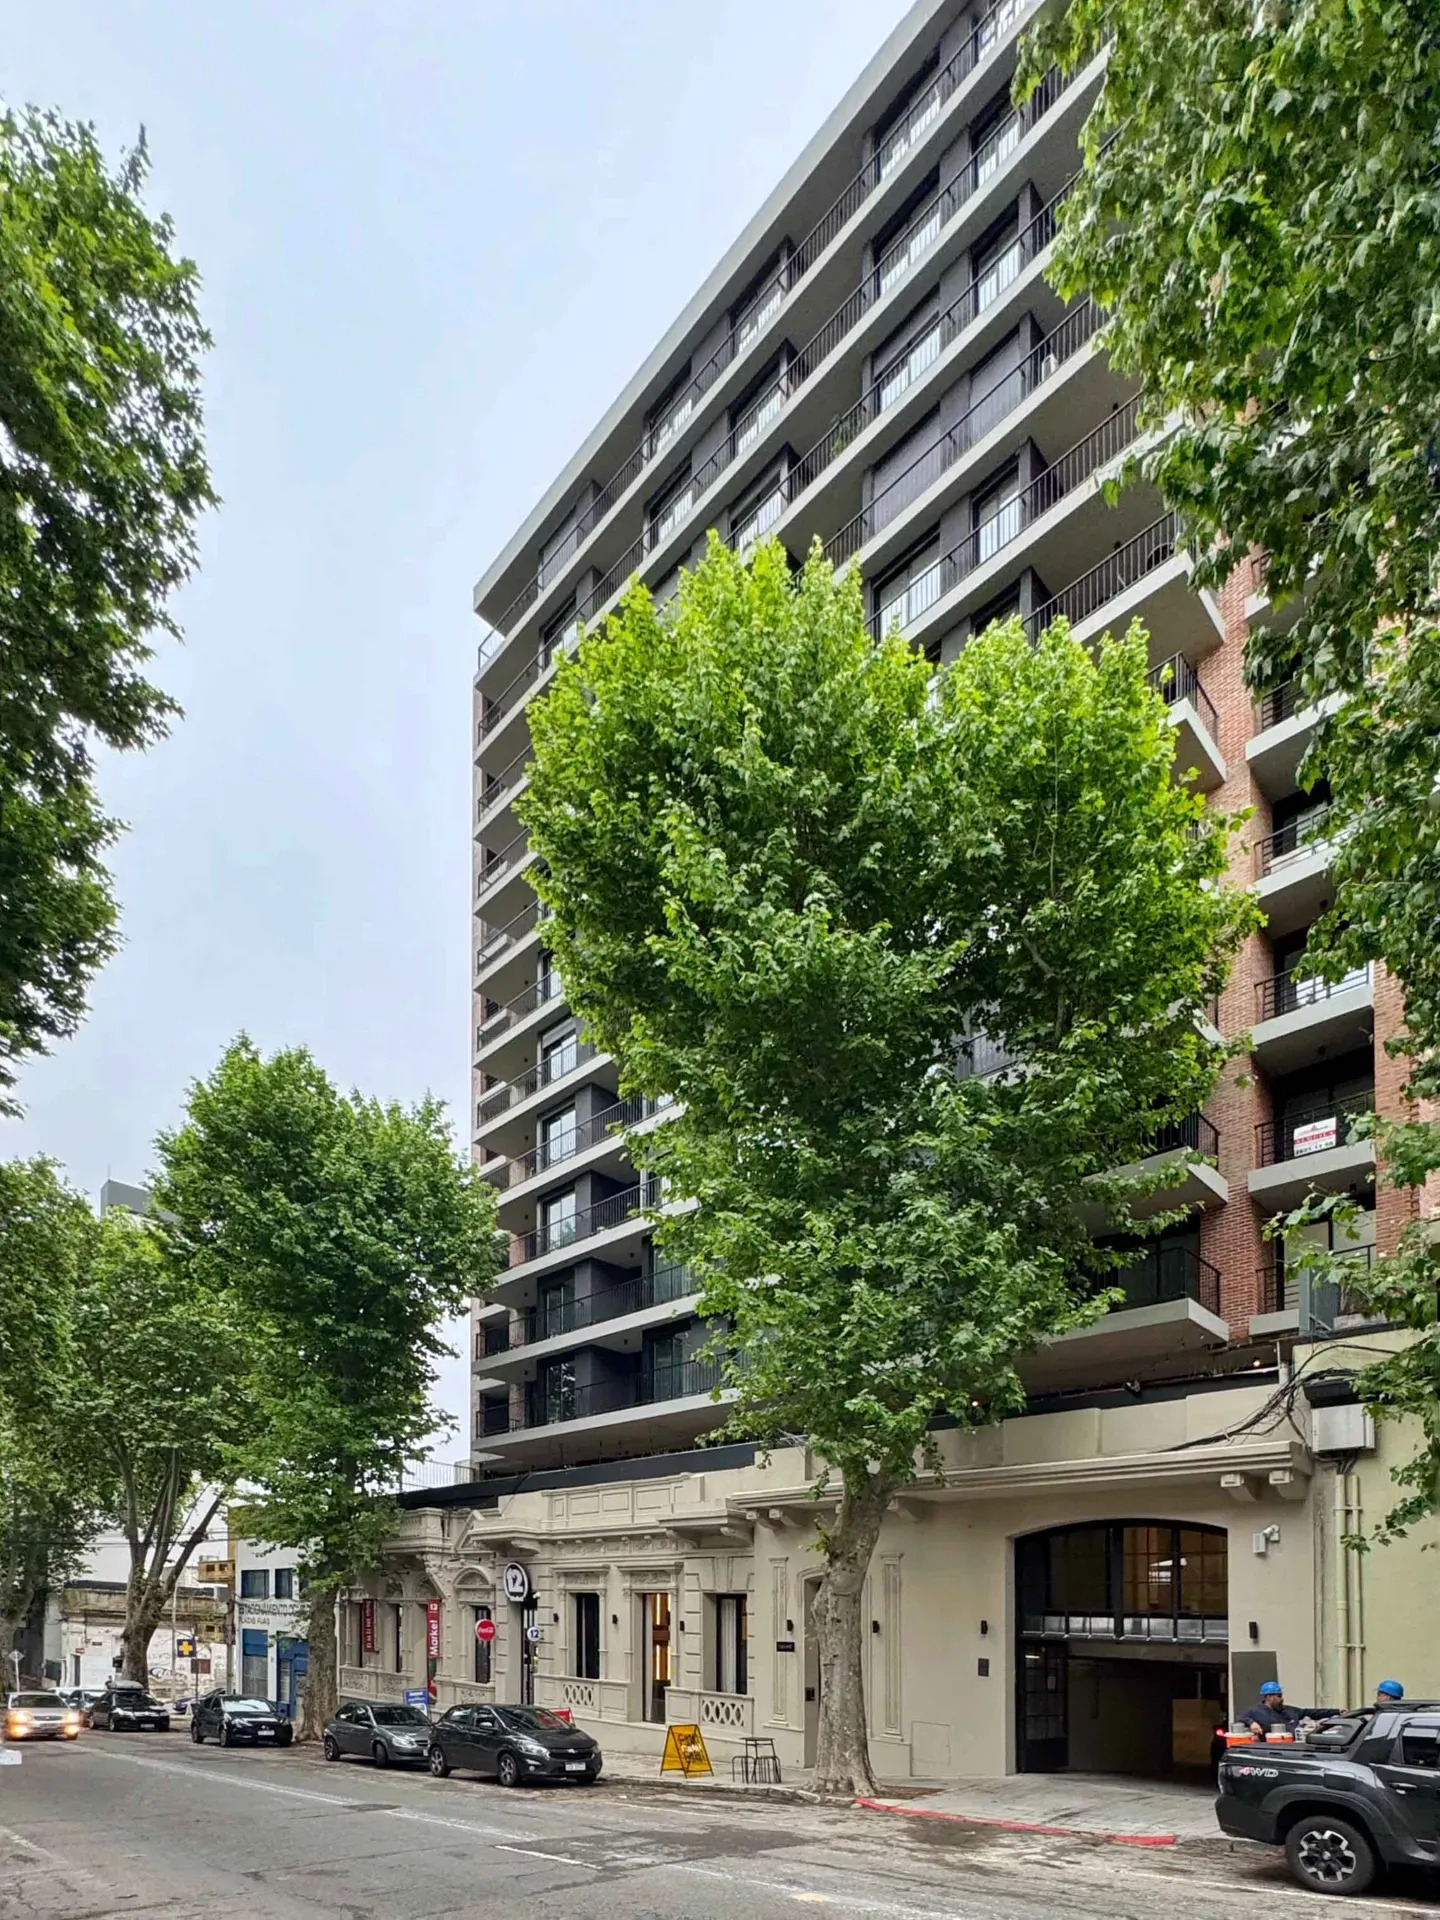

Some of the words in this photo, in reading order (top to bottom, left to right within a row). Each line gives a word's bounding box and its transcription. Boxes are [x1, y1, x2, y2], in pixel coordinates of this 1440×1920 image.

[506, 1567, 524, 1593] 12
[429, 1619, 439, 1656] Market
[530, 1629, 540, 1639] 12
[1239, 1766, 1279, 1778] 4WD
